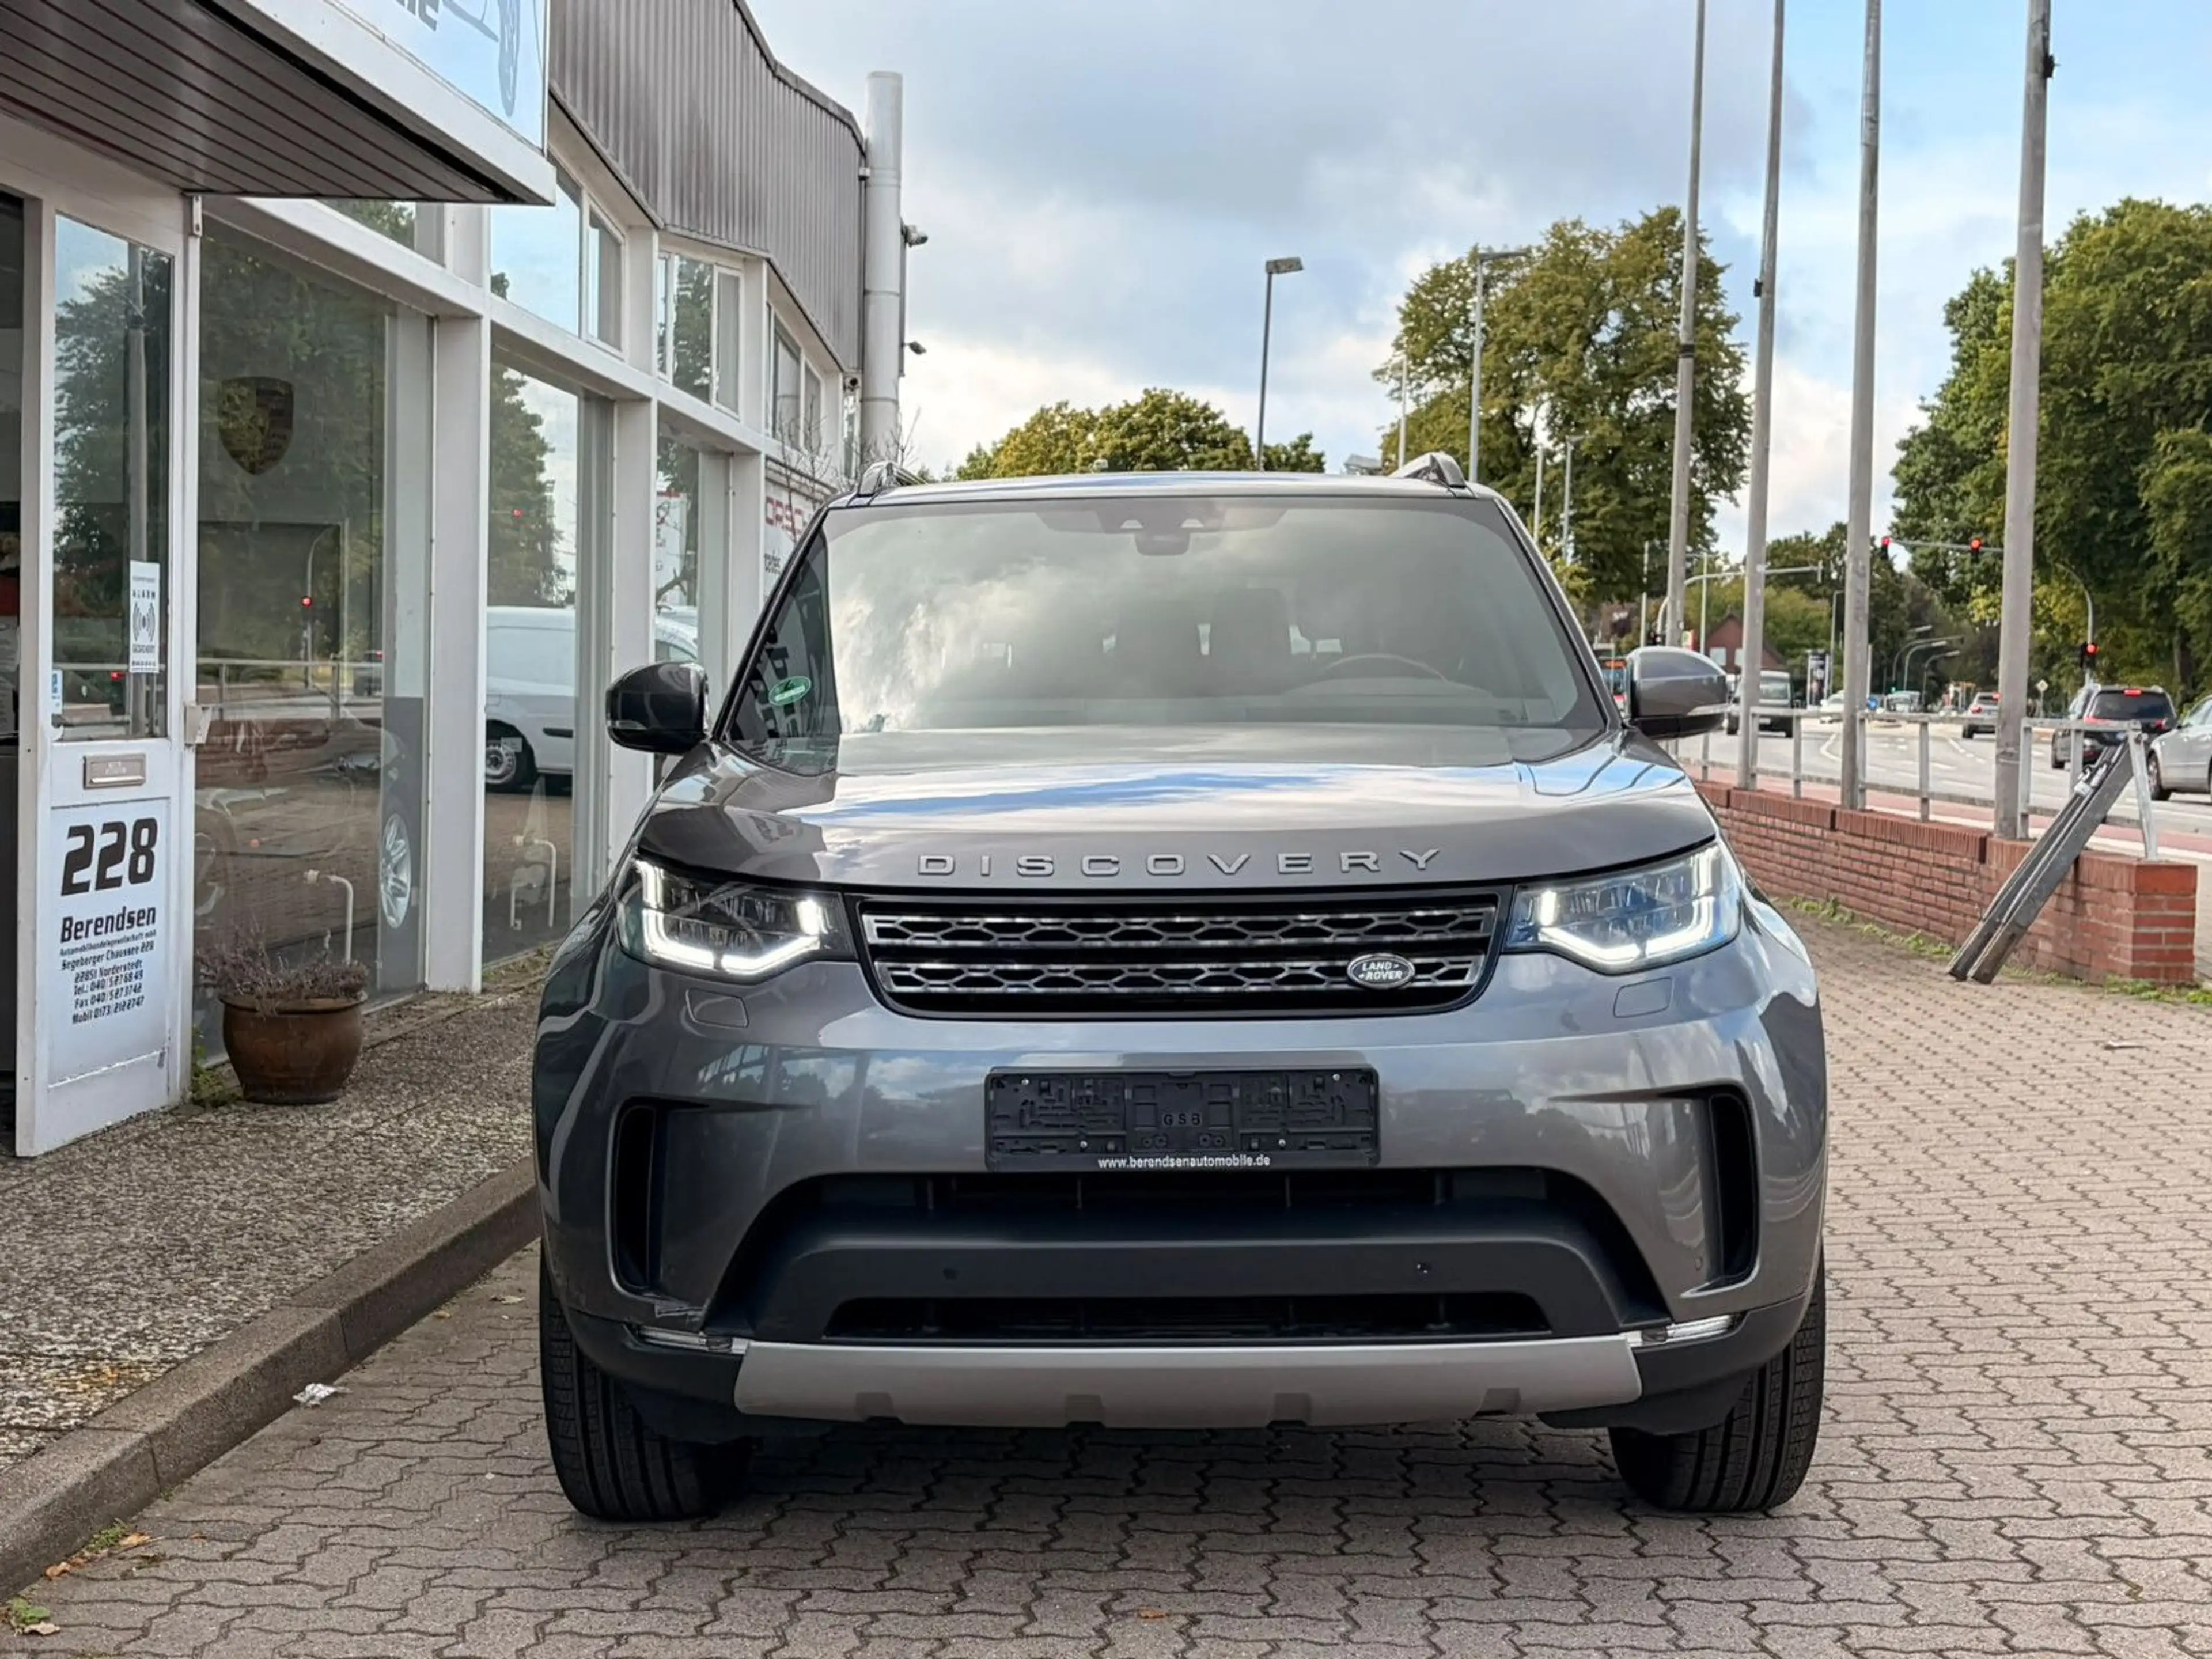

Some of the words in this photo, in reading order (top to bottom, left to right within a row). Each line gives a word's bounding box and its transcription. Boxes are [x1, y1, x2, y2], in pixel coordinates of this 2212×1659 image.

[61, 817, 157, 897] 228
[918, 848, 1439, 877] DISCOVERY
[60, 906, 156, 944] Berendsen
[1362, 961, 1393, 971] LAND
[1365, 970, 1403, 980] ROVER
[1097, 1153, 1271, 1169] www.berendsenautomobile.de
